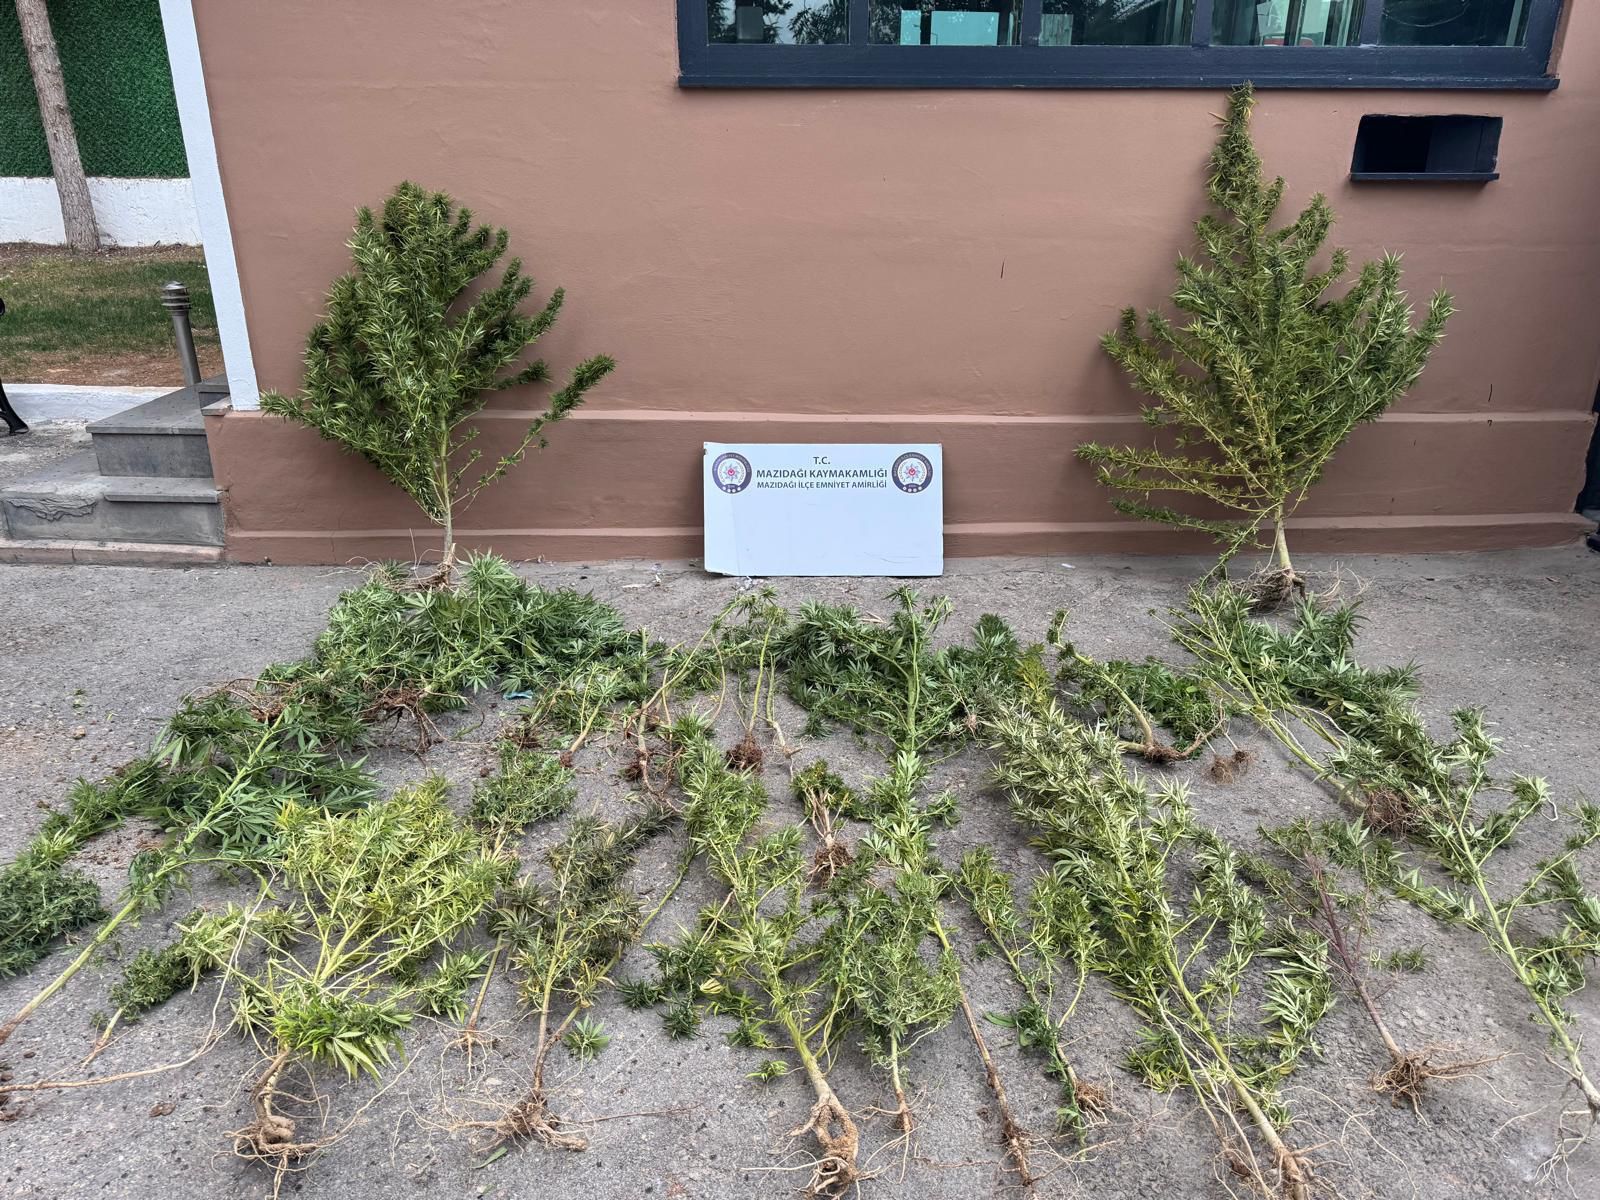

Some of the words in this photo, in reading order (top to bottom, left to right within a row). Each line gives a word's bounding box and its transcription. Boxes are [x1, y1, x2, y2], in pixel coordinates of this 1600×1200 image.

[813, 456, 831, 465] T.C.
[756, 468, 807, 478] MAZIDAĞI
[809, 468, 888, 478] KAYMAKAMLIĞI
[757, 480, 797, 489] MAZIDAĞI
[798, 480, 814, 490] İLÇE
[816, 480, 850, 489] EMNİYET
[851, 480, 887, 489] AMİRLİĞİ
